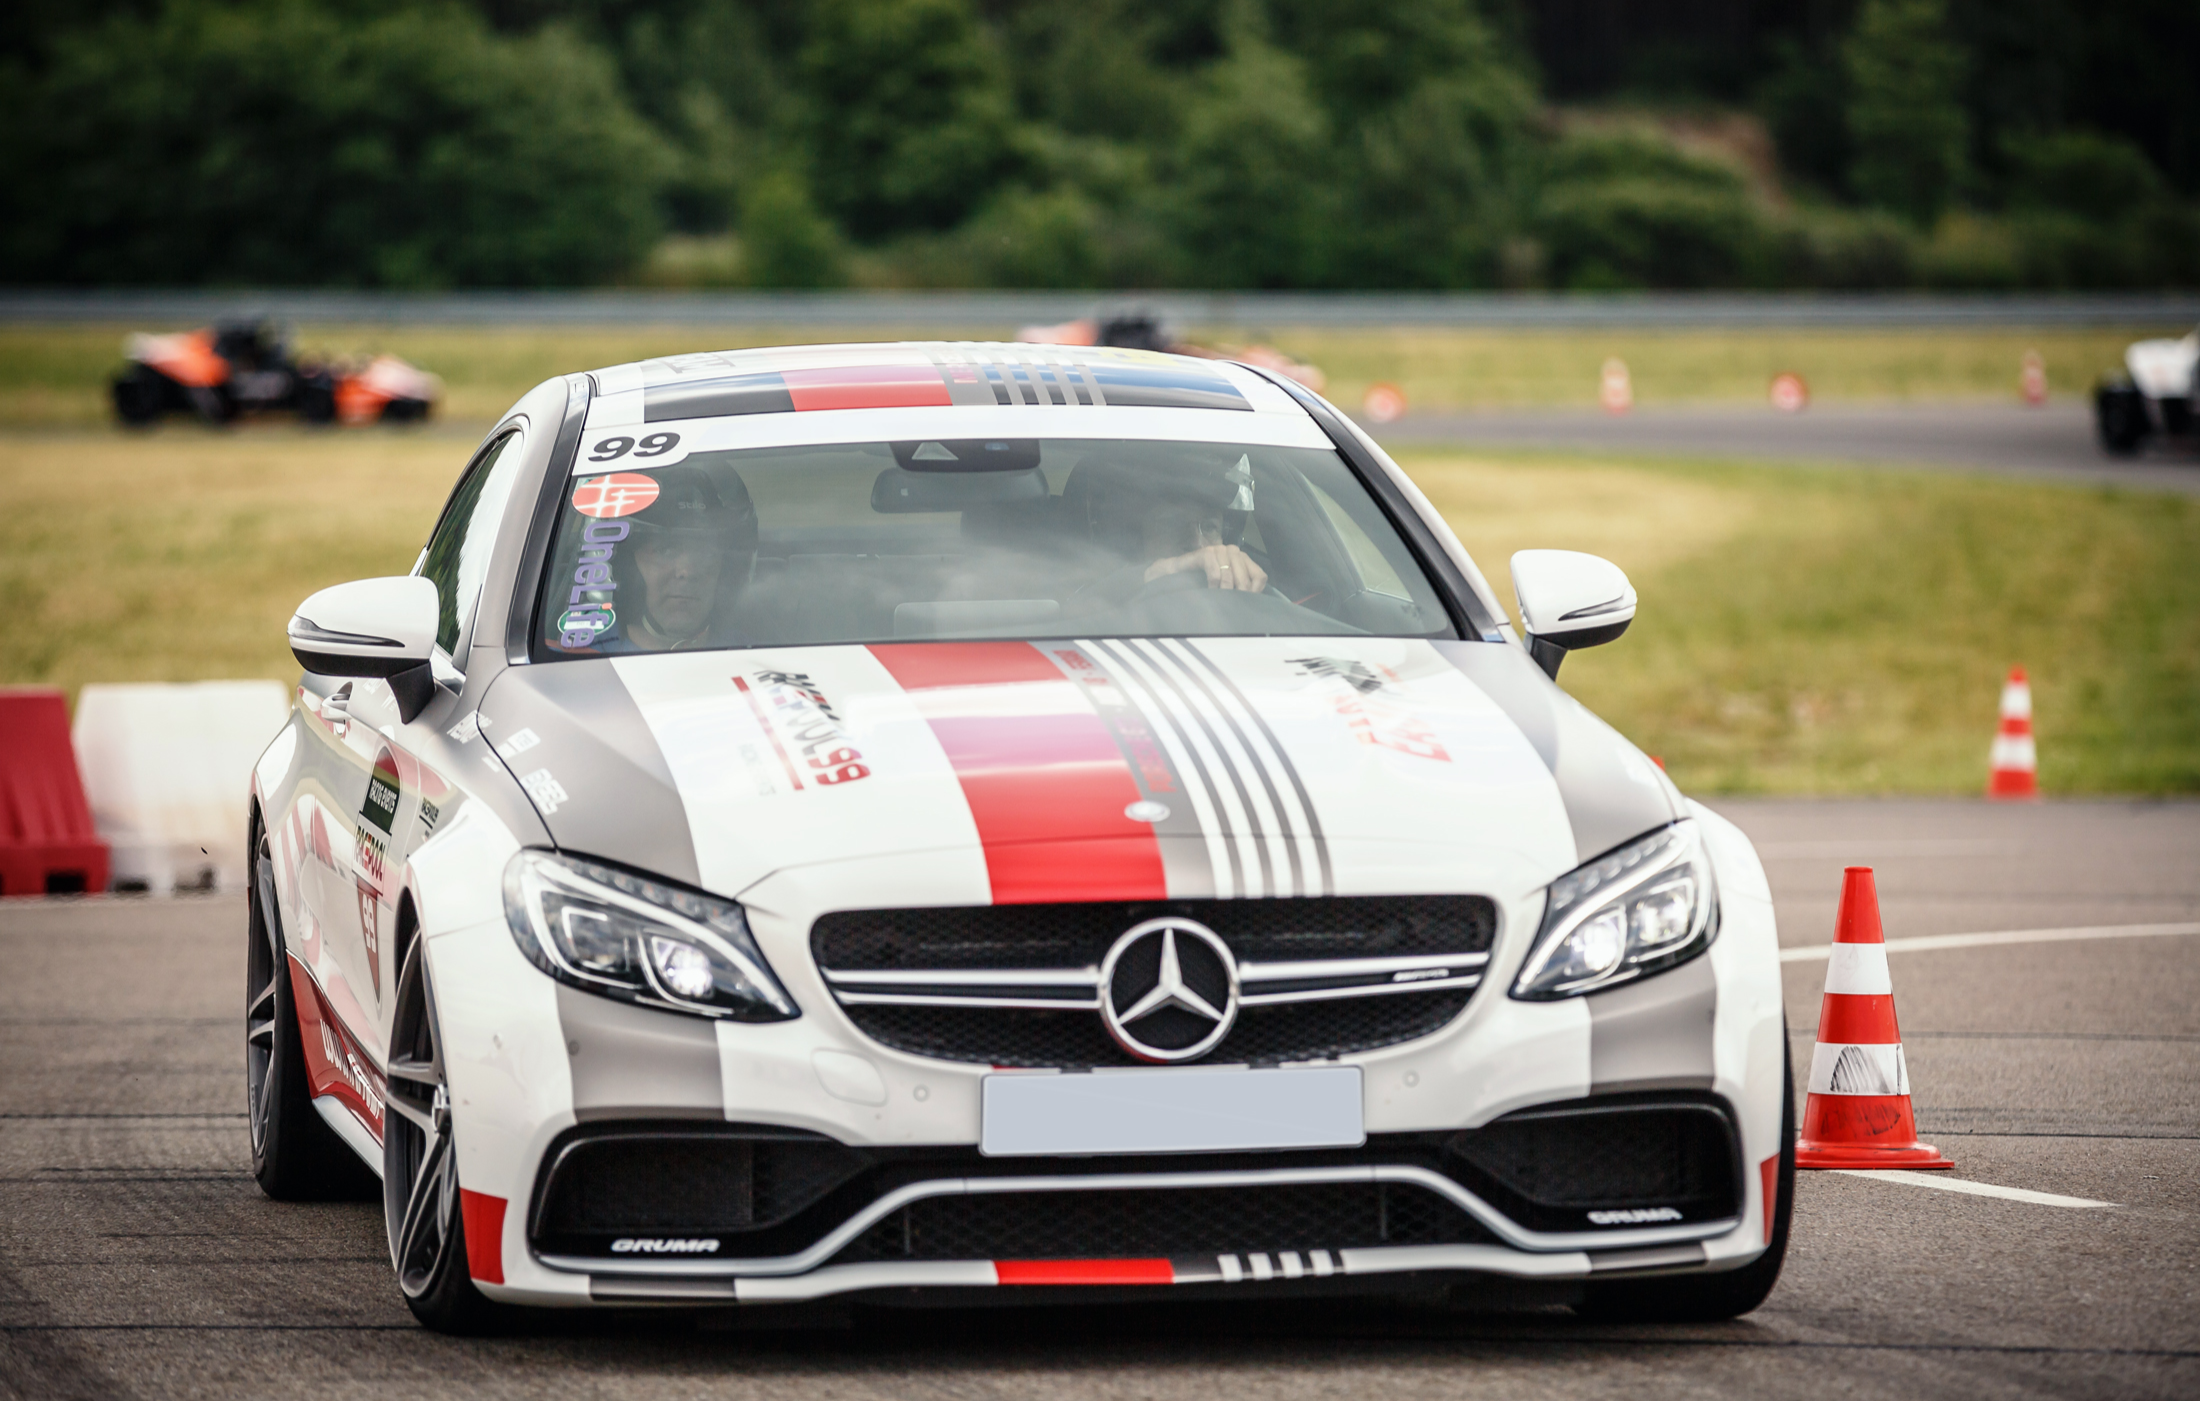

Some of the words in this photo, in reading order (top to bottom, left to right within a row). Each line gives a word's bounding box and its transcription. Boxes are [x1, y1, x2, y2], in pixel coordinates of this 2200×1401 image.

[588, 432, 681, 462] 99
[561, 521, 630, 648] OneLife
[362, 893, 377, 954] 99
[610, 1238, 720, 1252] GRUMA
